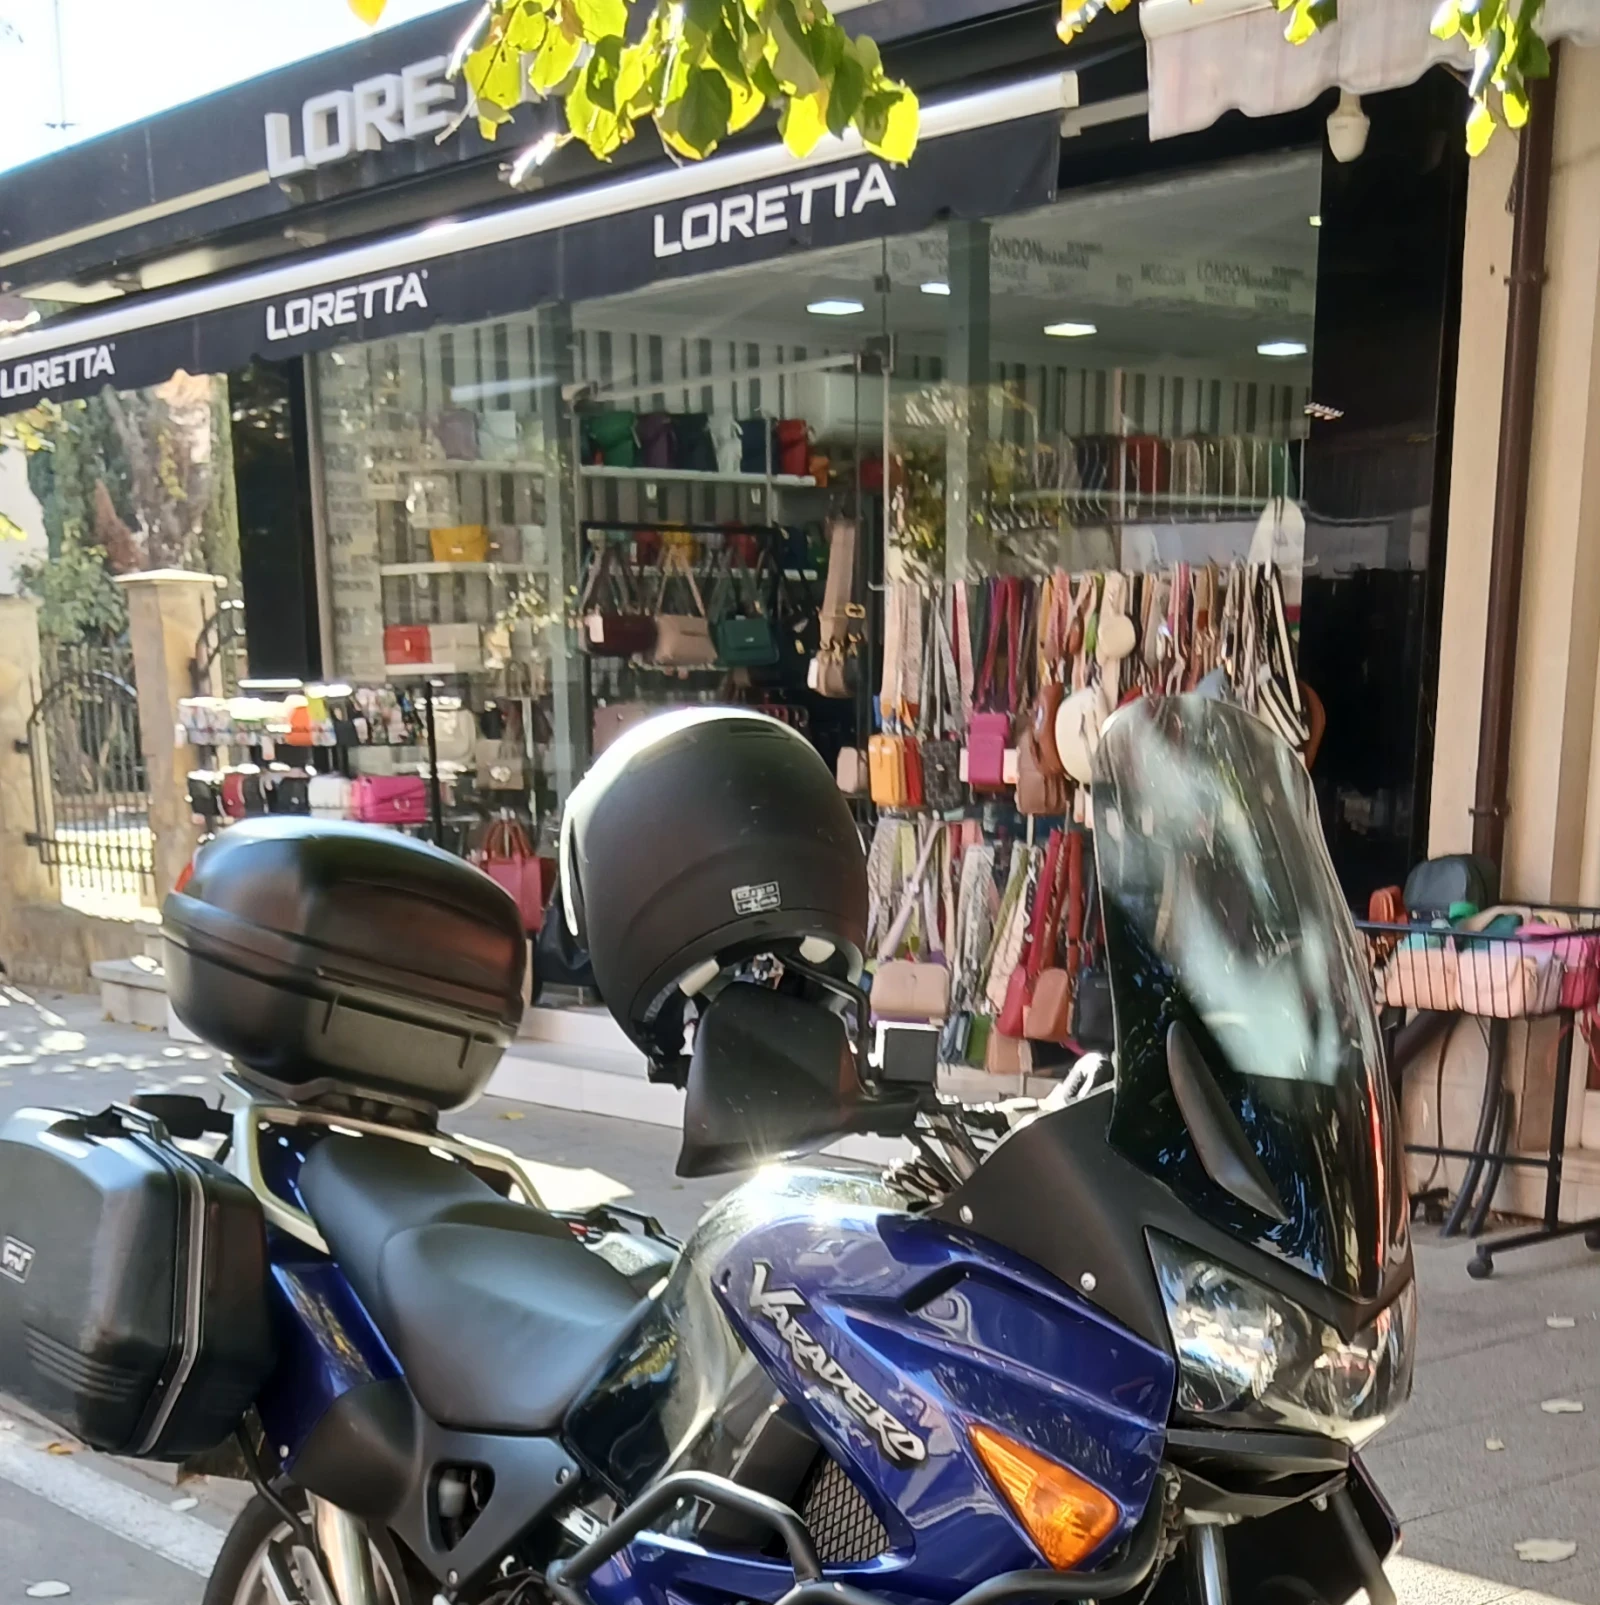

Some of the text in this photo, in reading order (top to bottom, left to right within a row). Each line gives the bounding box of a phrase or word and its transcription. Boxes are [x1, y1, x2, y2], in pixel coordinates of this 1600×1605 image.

[653, 163, 897, 258] LORETTA
[989, 236, 1043, 264] ONDON
[1196, 259, 1251, 289] LONDON
[266, 272, 428, 341] LORETTA
[0, 345, 115, 398] LORETTA
[748, 1259, 928, 1467] VARADERO
